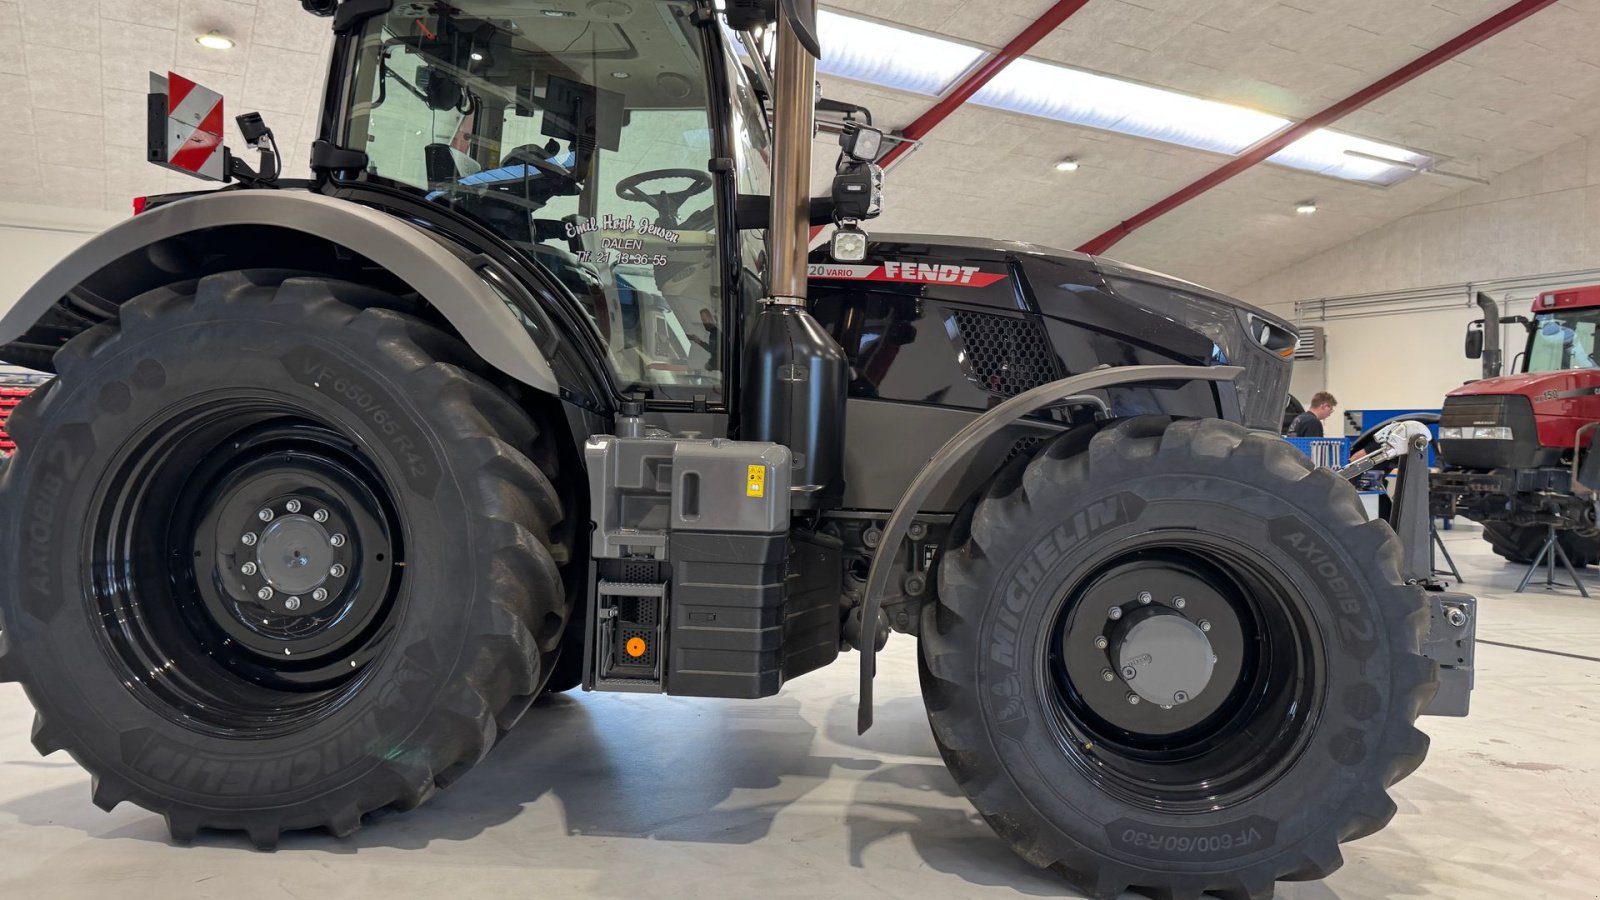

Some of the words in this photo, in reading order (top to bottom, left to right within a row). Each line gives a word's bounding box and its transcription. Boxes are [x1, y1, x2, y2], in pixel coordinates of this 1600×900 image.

[565, 217, 598, 238] Emil
[639, 218, 680, 243] Jensen
[602, 238, 643, 250] DALEN
[596, 252, 609, 263] 21
[807, 265, 825, 276] 20
[826, 269, 853, 277] VARIO
[884, 261, 980, 284] FENDT
[991, 496, 1118, 668] MICHELIN
